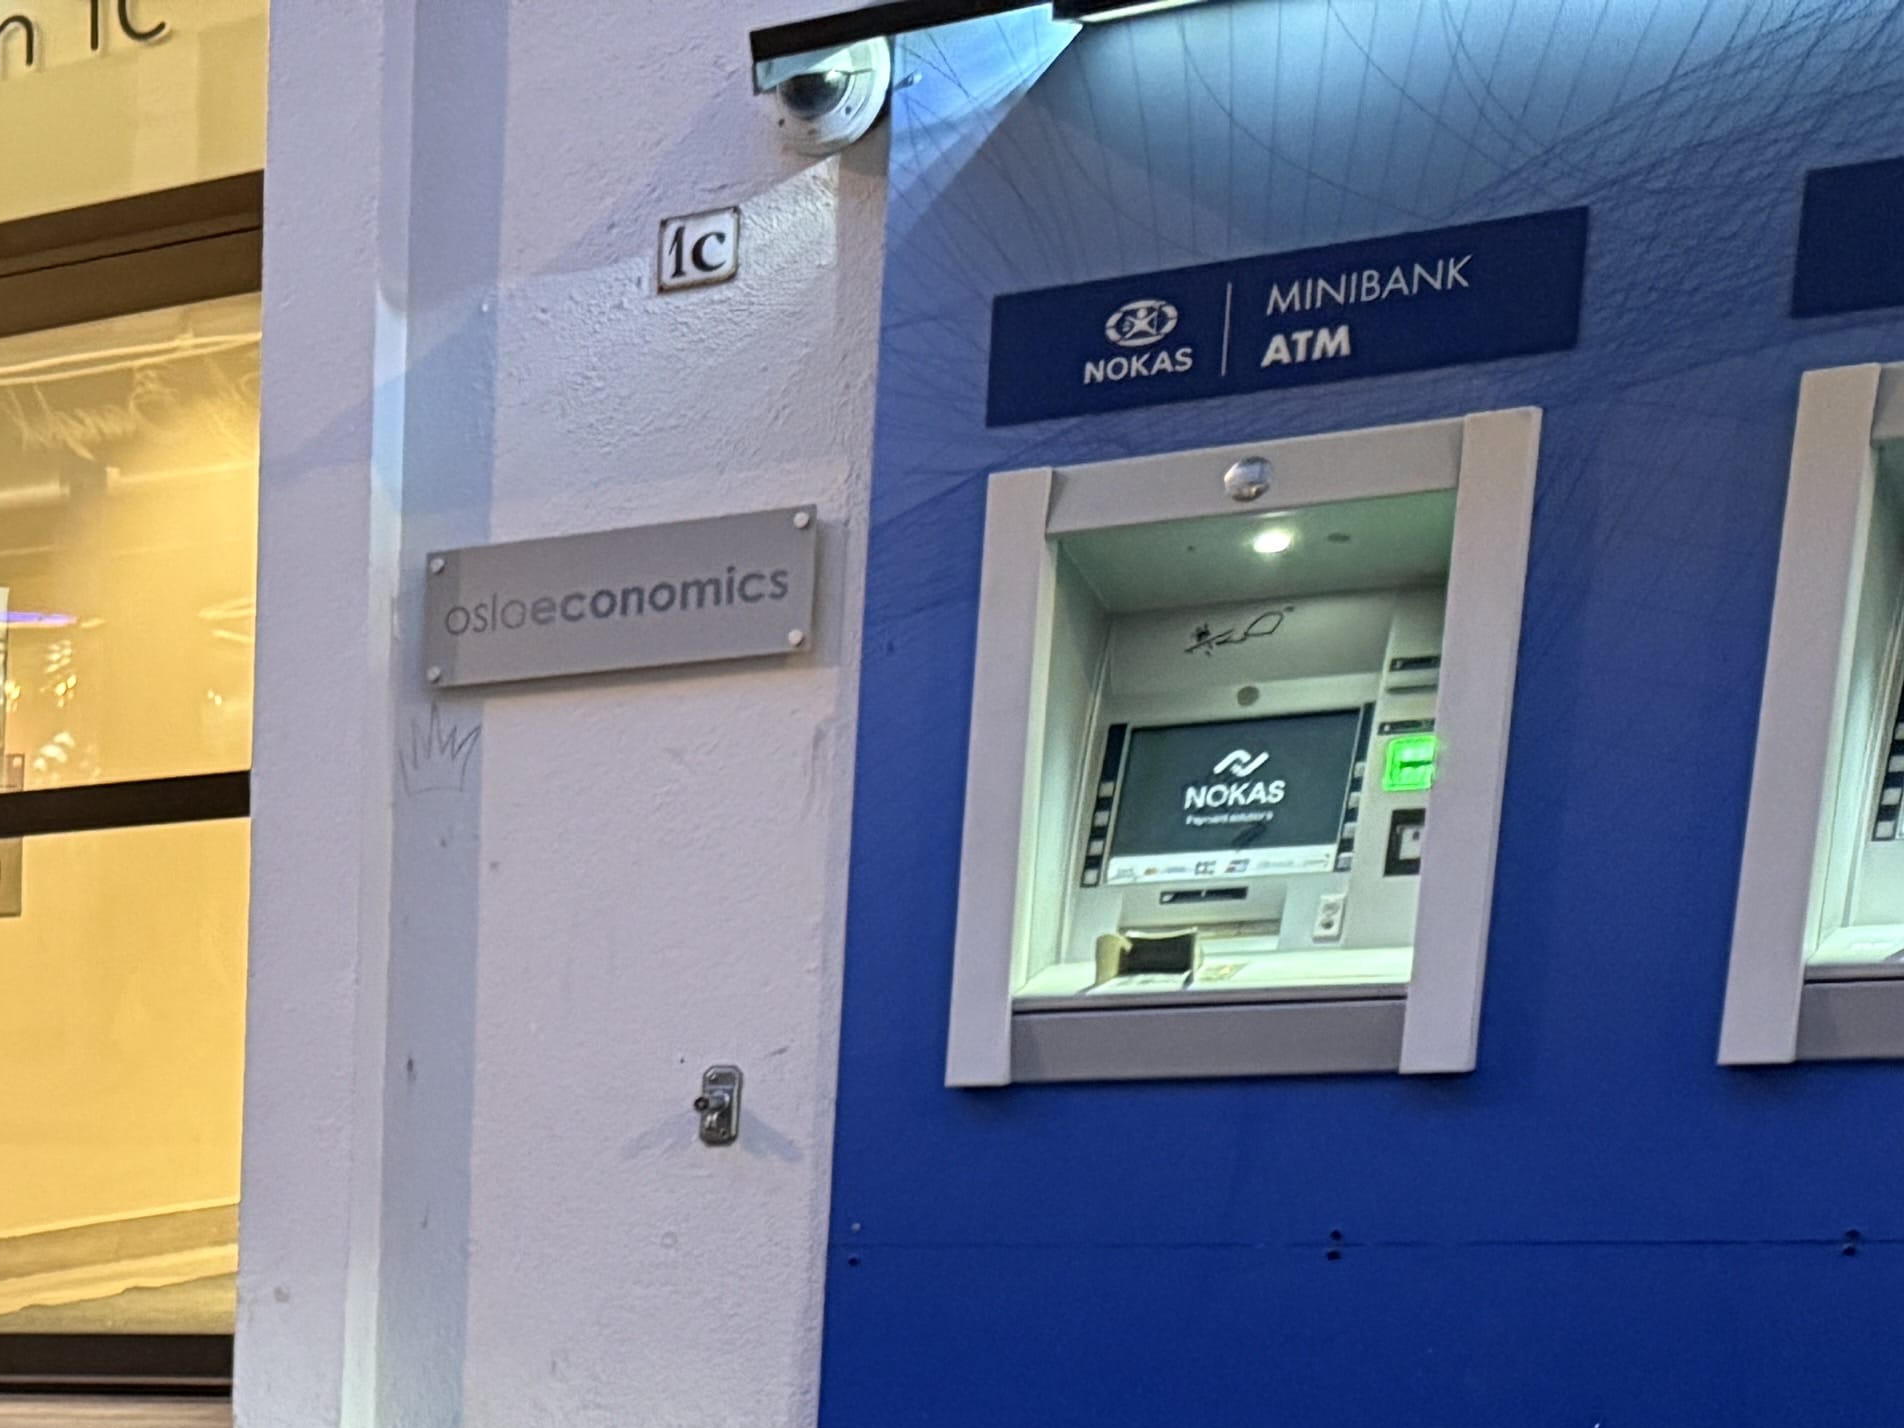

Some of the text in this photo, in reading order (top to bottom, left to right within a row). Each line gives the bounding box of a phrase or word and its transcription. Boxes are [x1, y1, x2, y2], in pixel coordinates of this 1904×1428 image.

[1265, 254, 1473, 316] MINIBANK
[1082, 347, 1194, 385] NOKAS
[1260, 324, 1352, 368] ATM
[444, 565, 789, 637] osloeconomics
[1184, 779, 1287, 810] NOKAS
